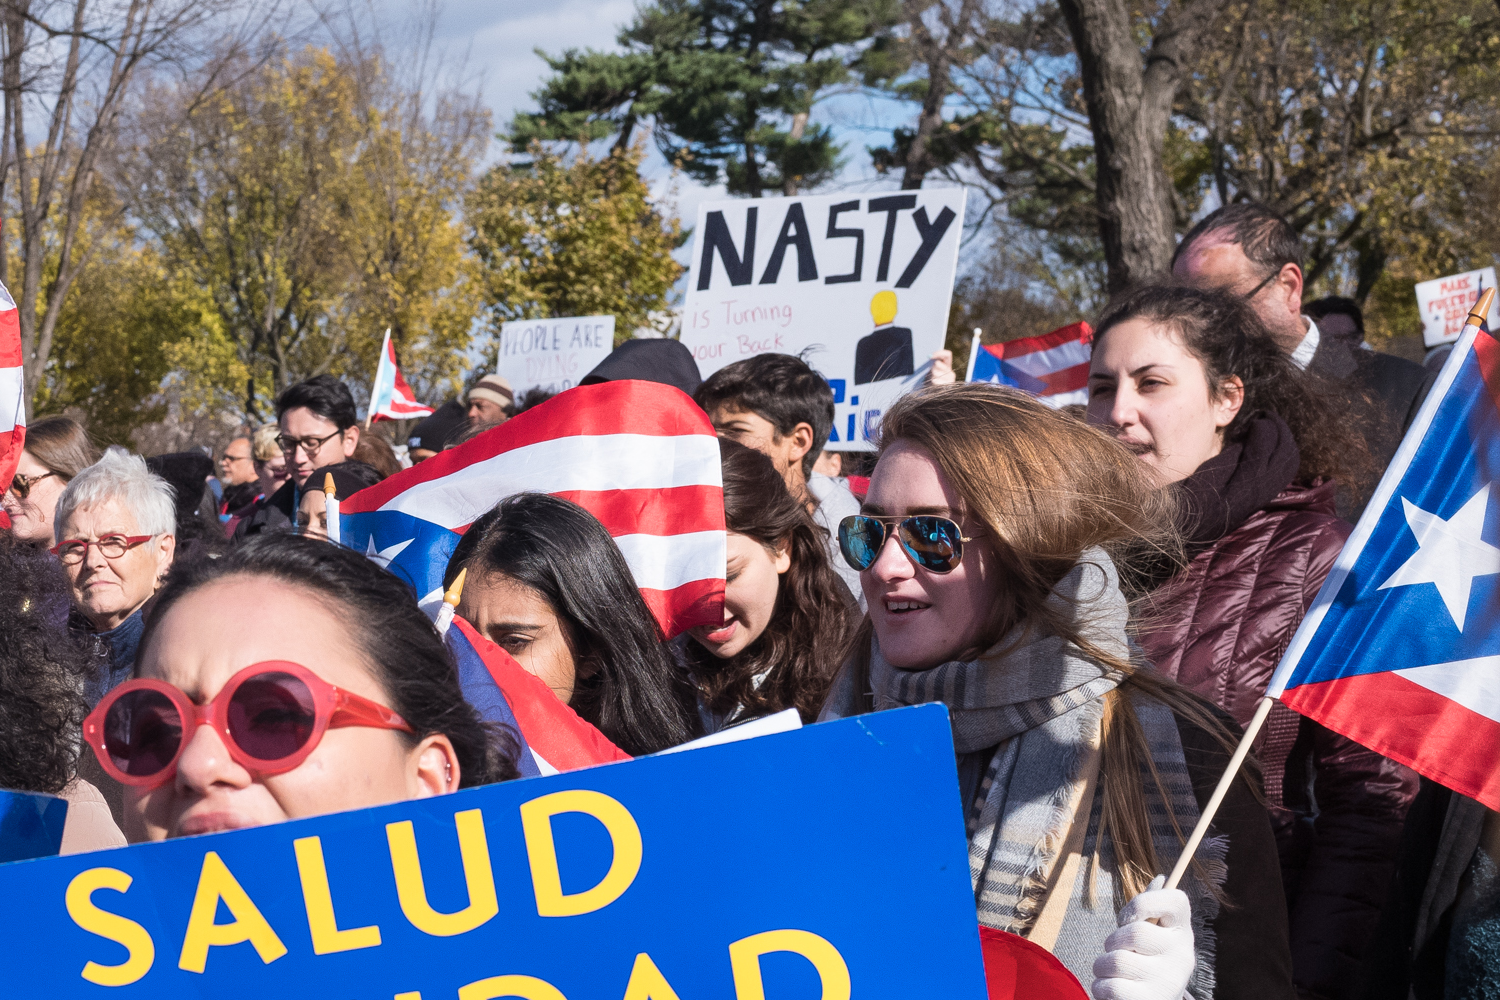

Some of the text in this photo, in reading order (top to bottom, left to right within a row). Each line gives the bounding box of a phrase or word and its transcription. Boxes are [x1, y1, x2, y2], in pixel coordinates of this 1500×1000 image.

[697, 195, 956, 291] NASTY
[692, 300, 793, 329] is Turning
[569, 324, 604, 348] ARE
[737, 333, 784, 354] Back
[64, 790, 643, 987] SALUD
